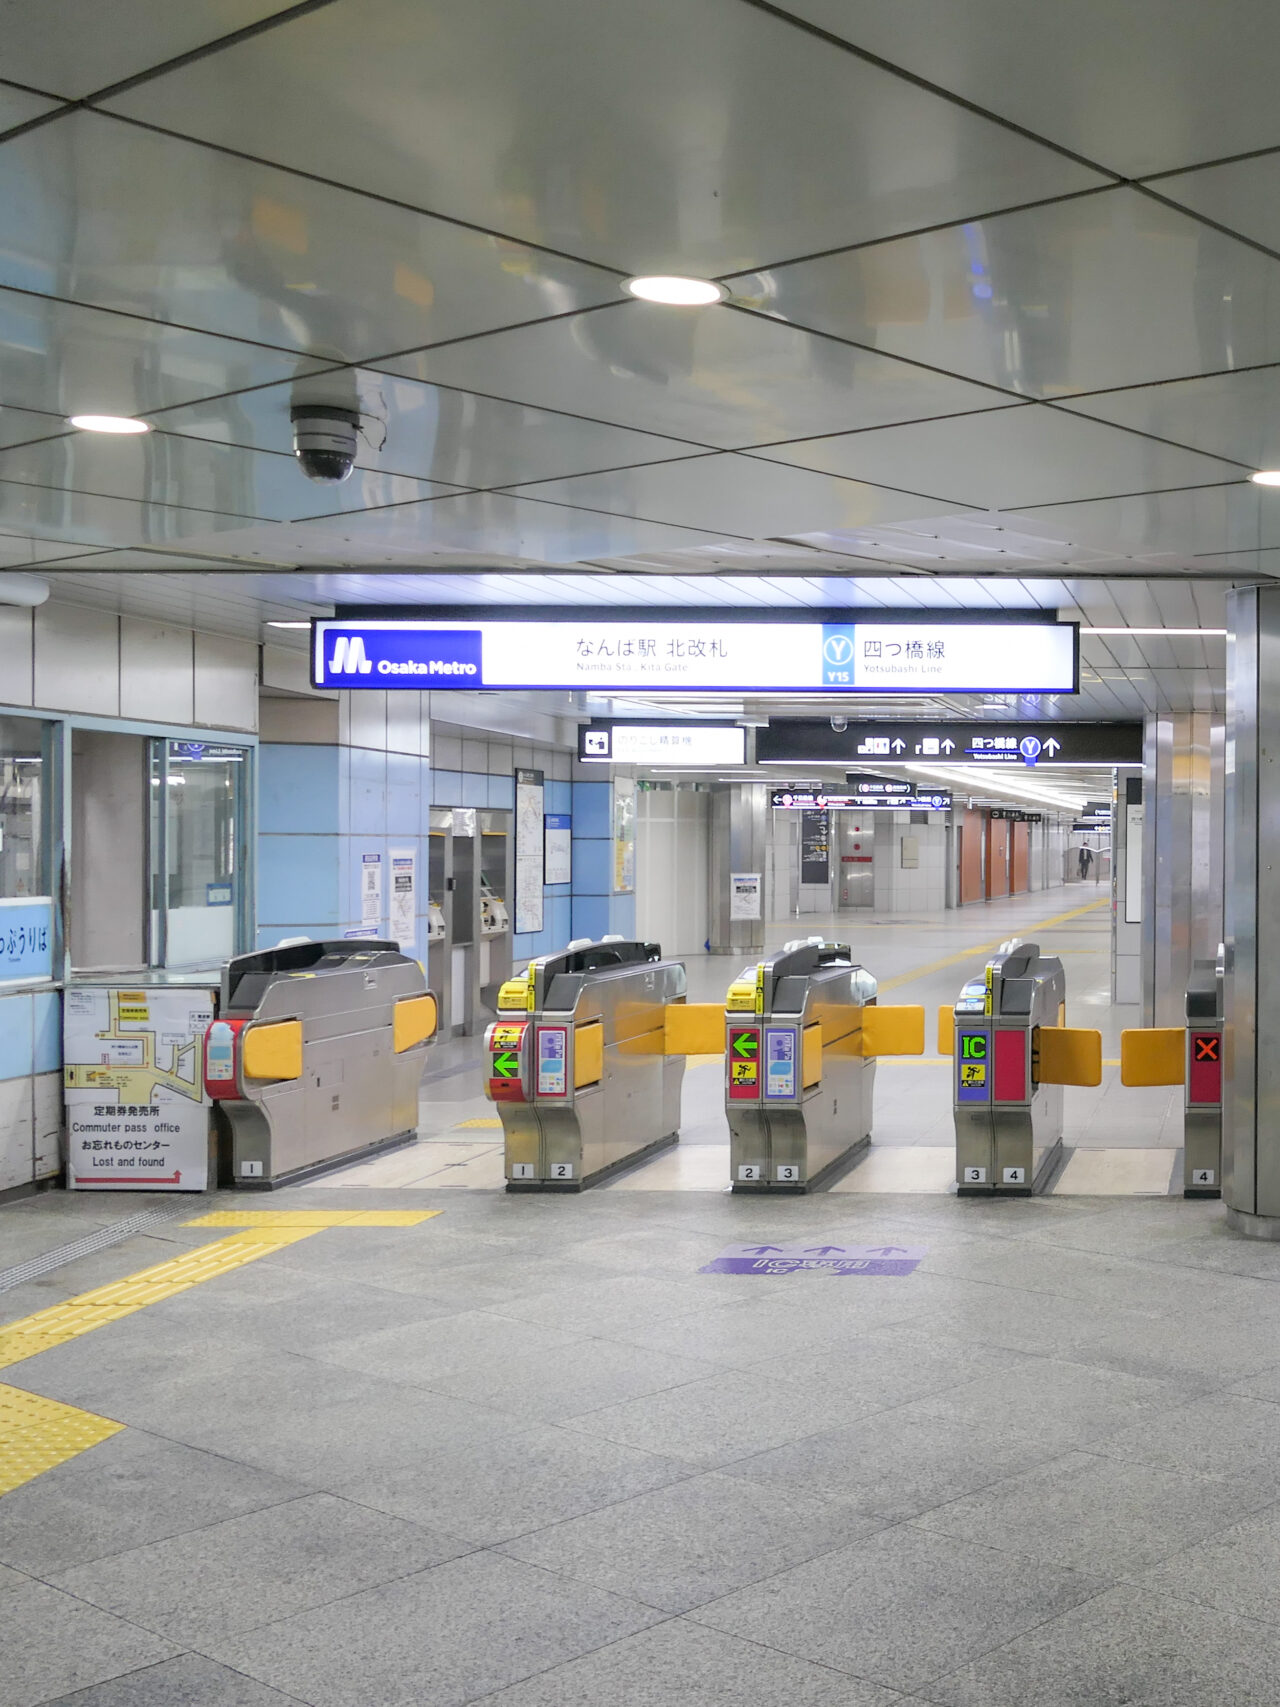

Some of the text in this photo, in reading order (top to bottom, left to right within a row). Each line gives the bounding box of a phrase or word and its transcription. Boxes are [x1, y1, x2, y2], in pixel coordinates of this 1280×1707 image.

[577, 638, 727, 657] なんば駅 北改札
[831, 640, 845, 660] Y
[864, 640, 945, 659] 四つ橋線
[377, 660, 477, 675] Osaka Metro
[576, 662, 612, 672] Namba
[640, 662, 661, 672] Kita
[664, 662, 688, 672] Gate
[864, 664, 942, 673] Yotsubashi Line
[828, 672, 849, 682] Y15
[962, 1036, 986, 1058] IC
[94, 1106, 160, 1117] 定期券発売所
[72, 1123, 180, 1134] Commuter pass office
[82, 1140, 170, 1151] お忘れものセンター
[92, 1157, 165, 1167] Lost and found
[557, 1165, 566, 1177] 2
[745, 1167, 754, 1179] 2
[784, 1167, 793, 1179] 3
[971, 1169, 980, 1180] 3
[1010, 1170, 1018, 1181] 4
[1199, 1171, 1208, 1182] 4
